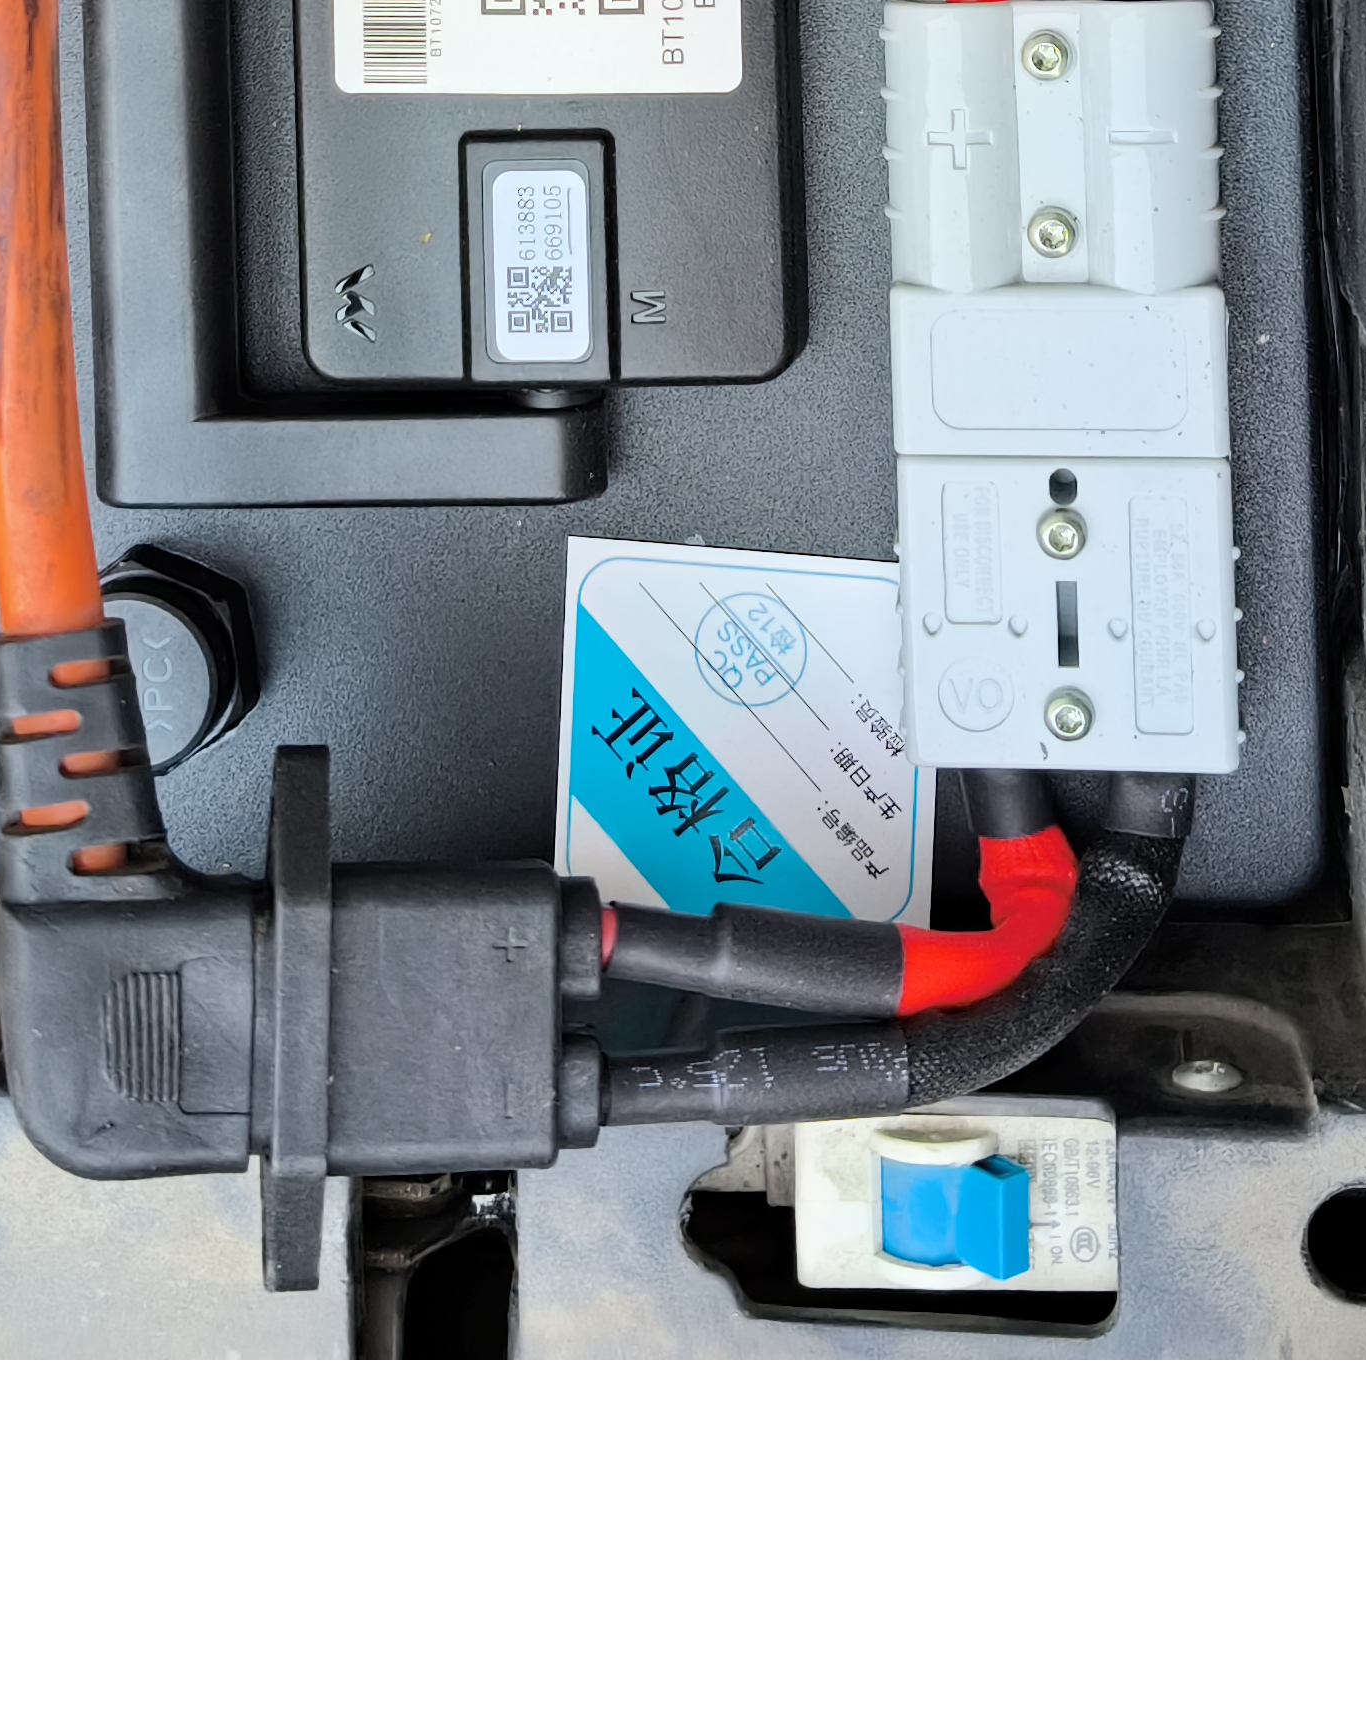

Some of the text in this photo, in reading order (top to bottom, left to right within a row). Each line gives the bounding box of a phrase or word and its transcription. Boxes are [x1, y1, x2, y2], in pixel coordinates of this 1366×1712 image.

[517, 185, 536, 261] 613883
[543, 185, 563, 261] 669105
[630, 290, 666, 324] M
[714, 650, 744, 689] QC
[717, 620, 778, 687] PASS
[591, 686, 782, 885] 合格证
[1050, 1244, 1064, 1265] ON
